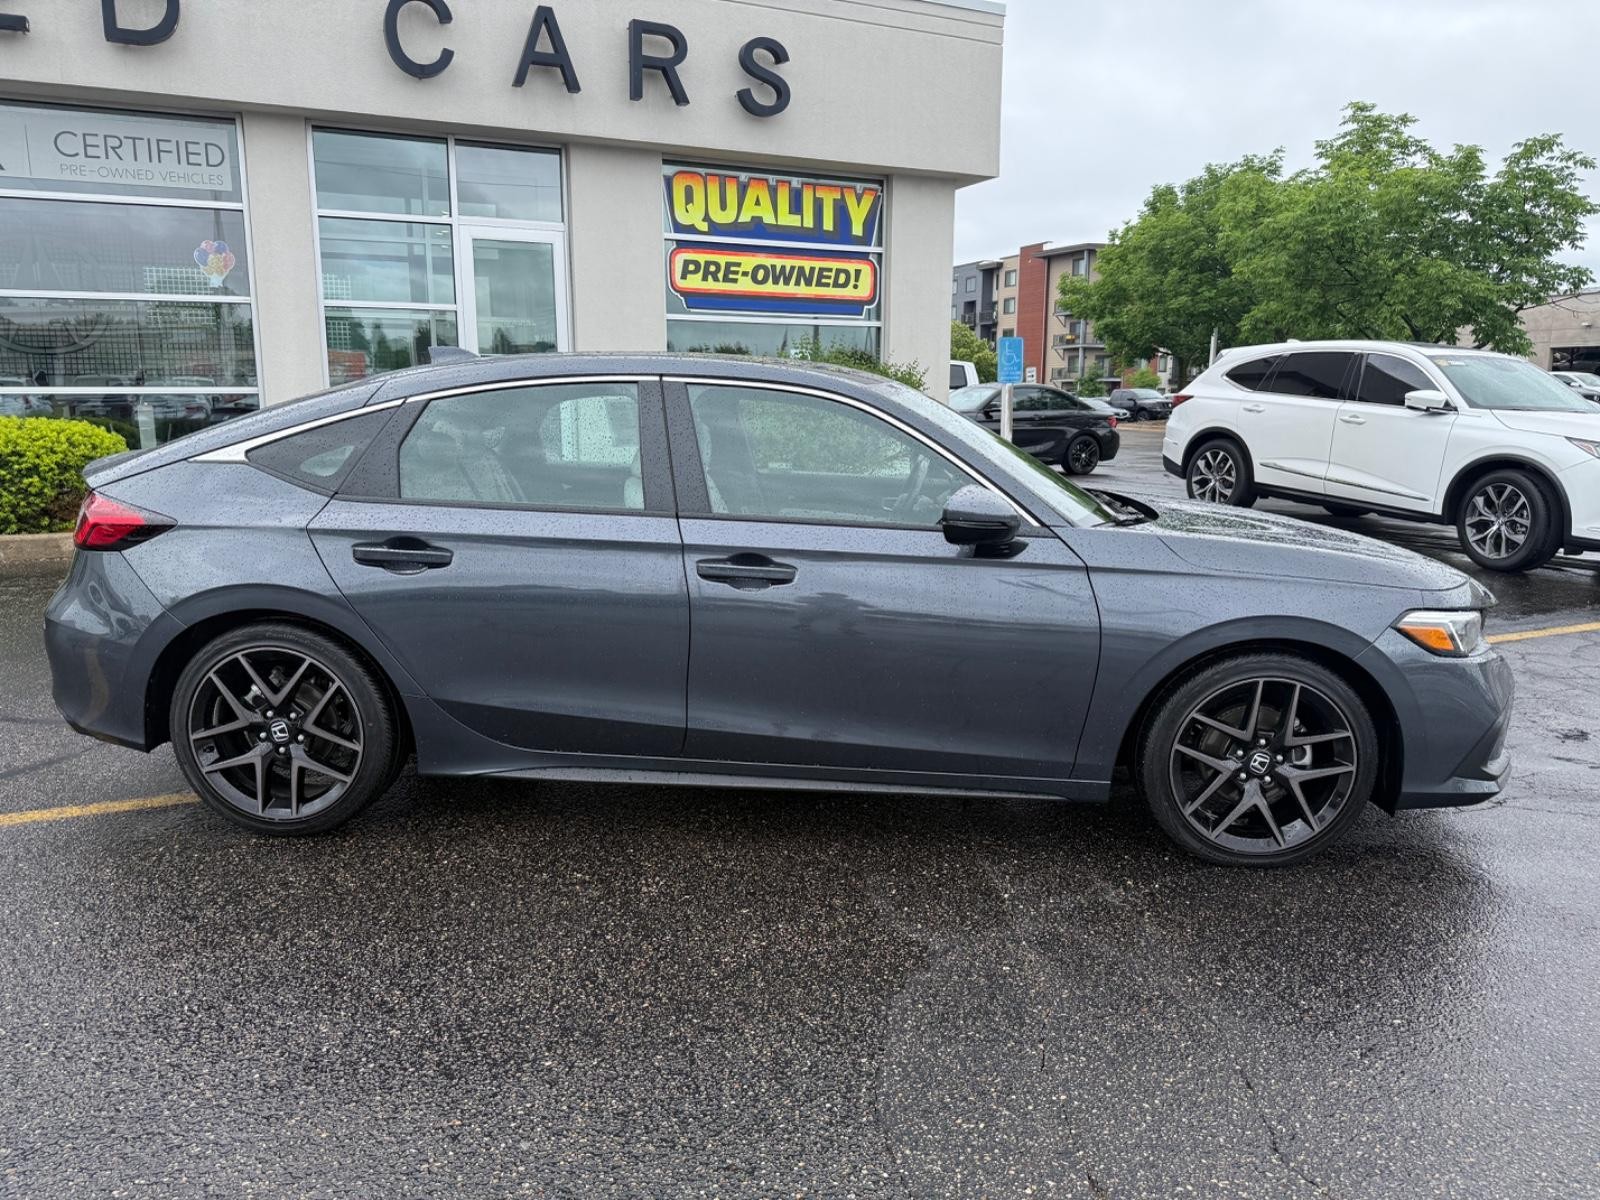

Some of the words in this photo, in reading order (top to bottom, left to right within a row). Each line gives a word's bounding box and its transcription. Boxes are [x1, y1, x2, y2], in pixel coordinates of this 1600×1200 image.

[383, 0, 791, 117] CARS
[53, 130, 225, 167] CERTIFIED
[60, 163, 154, 181] PRE-OWNED
[159, 170, 224, 186] VEHICLES
[672, 169, 877, 237] QUALITY
[679, 259, 862, 290] PRE-OWNED!
